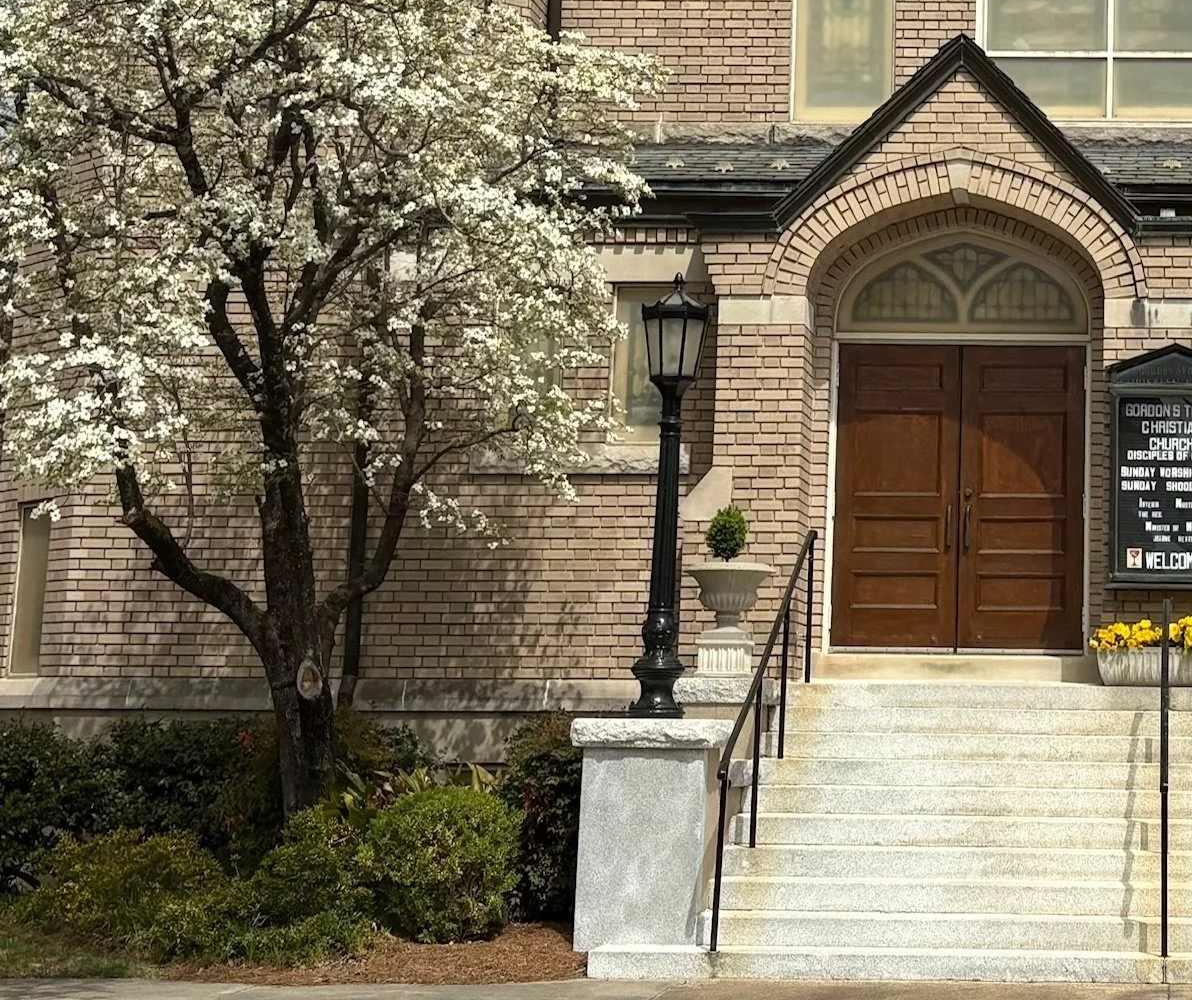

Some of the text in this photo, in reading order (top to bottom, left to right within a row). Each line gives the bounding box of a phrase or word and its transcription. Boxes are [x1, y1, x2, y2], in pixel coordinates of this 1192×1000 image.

[1127, 450, 1174, 461] DISCIPLES
[1176, 451, 1188, 461] OF
[1121, 466, 1155, 477] SUNDAY
[1121, 481, 1156, 492] SUNDAY
